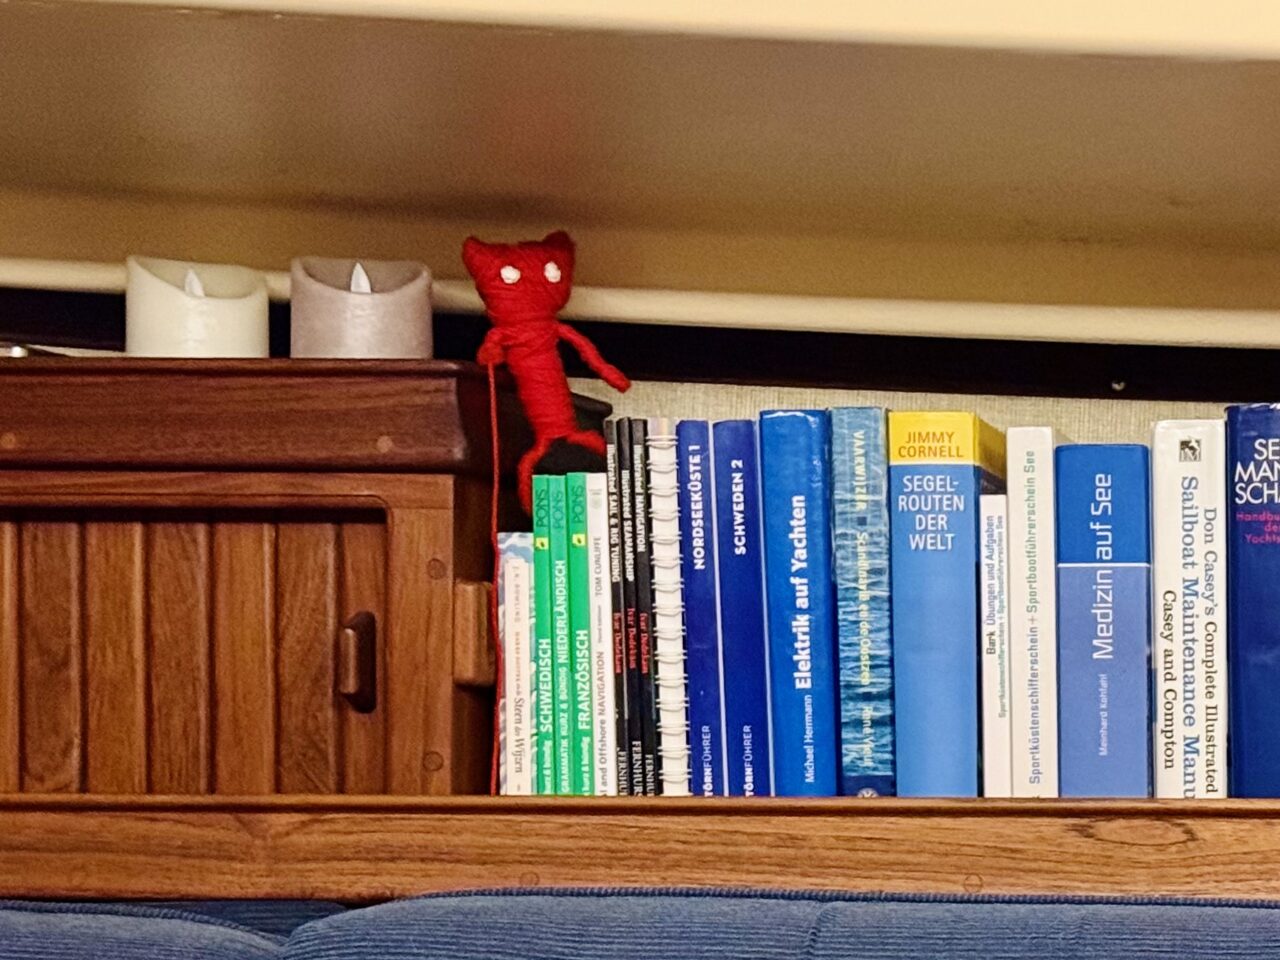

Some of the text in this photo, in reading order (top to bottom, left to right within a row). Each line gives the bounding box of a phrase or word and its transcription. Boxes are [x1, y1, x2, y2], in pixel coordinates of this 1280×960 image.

[898, 445, 964, 458] CORNELL
[906, 431, 955, 444] JIMMY
[1023, 450, 1036, 473] See
[536, 489, 549, 527] PONS
[551, 490, 565, 530] PONS
[570, 485, 585, 523] PONS
[606, 444, 623, 583] Illustrated SAIL & RIG TUNING
[633, 444, 647, 552] Illustrated NAVIGATION
[688, 455, 706, 569] NORDSEEKÜSTE
[731, 459, 746, 555] SCHWEDEN 2
[898, 494, 965, 512] ROUTEN
[902, 475, 959, 492] SEGEL-
[621, 470, 636, 582] Illustrated SEAMANSHIP
[909, 533, 955, 551] WELT
[915, 514, 948, 531] DER
[1024, 477, 1040, 613] Sportbootführerschein
[1181, 476, 1199, 570] Sailboat
[592, 537, 602, 575] CUNLIFFE
[594, 577, 603, 597] TOM
[984, 515, 997, 654] Bark Übungen und Aufgaben
[1090, 474, 1113, 659] Medizin auf See
[554, 560, 569, 663] NIEDERLÄNDISCH
[789, 495, 813, 689] Elektrik auf Yachten
[575, 630, 590, 730] FRANZÖSISCH
[1160, 590, 1178, 770] Casey and Compton
[1181, 577, 1200, 728] Maintenance
[1201, 508, 1219, 793] Don Casey's Complete Illustrated
[513, 698, 527, 725] Steen
[538, 638, 553, 733] SCHWEDISCH
[596, 651, 606, 716] NAVIGATION
[598, 719, 608, 765] Offshore
[803, 745, 815, 783] Michael
[600, 767, 608, 787] and
